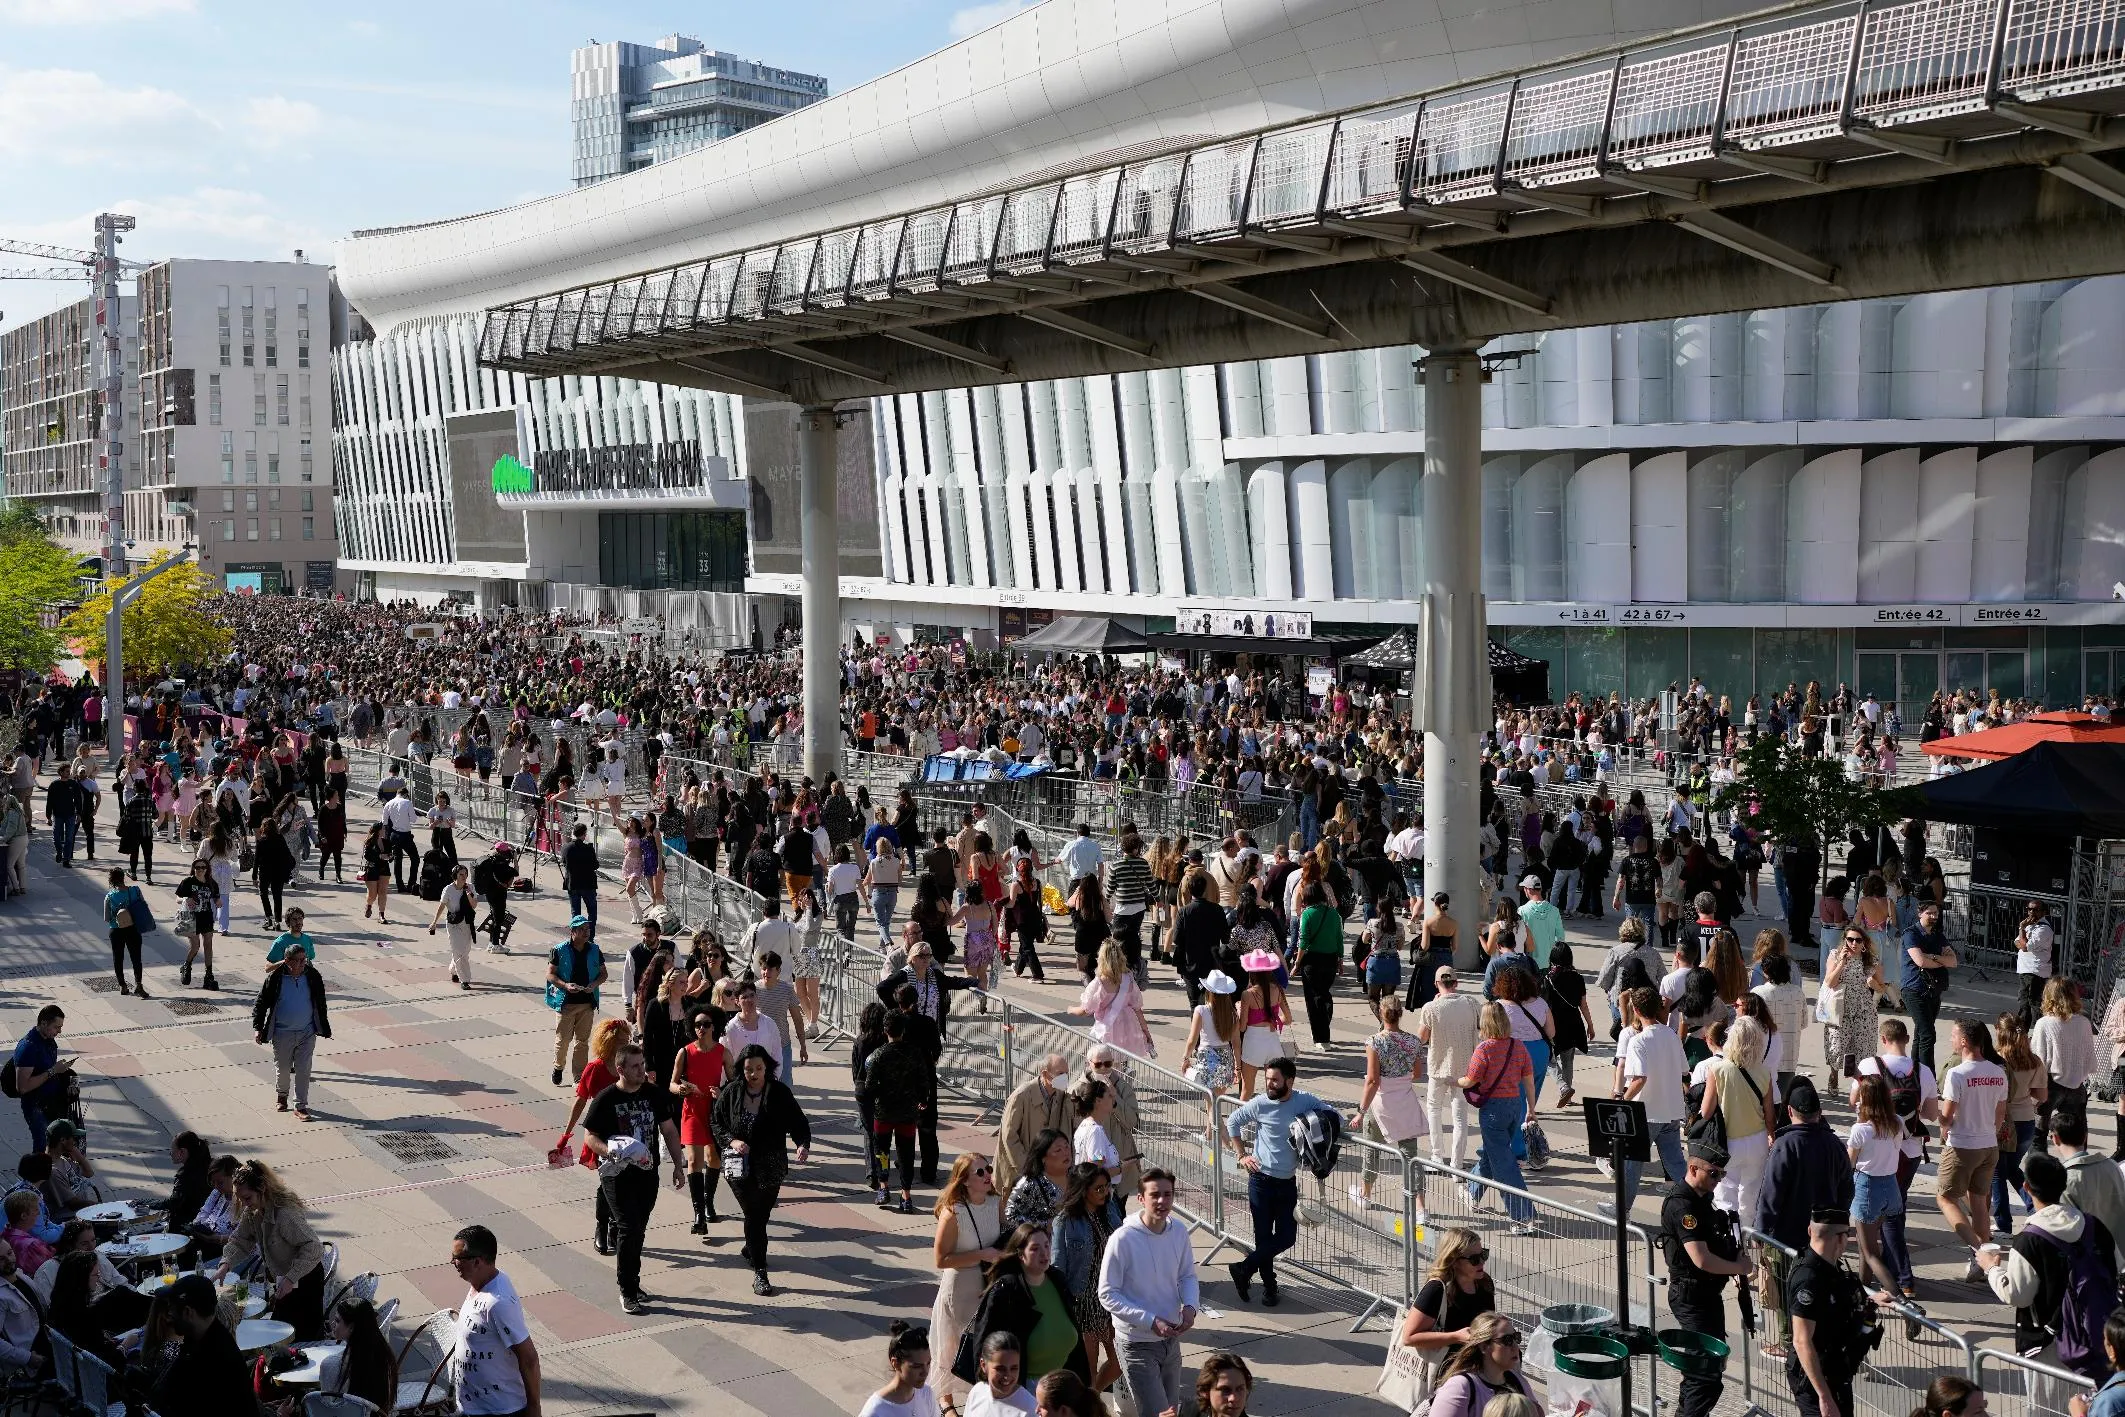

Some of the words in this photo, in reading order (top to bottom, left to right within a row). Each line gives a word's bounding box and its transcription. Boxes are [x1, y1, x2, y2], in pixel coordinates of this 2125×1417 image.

[534, 449, 571, 491] PARIS
[657, 440, 702, 488] ARENA
[699, 559, 709, 572] 33
[1573, 609, 1578, 619] 1
[1582, 608, 1589, 619] à
[1593, 609, 1606, 619] 41
[1623, 609, 1640, 619] 42
[1643, 609, 1651, 619] à
[1655, 609, 1671, 619] 67
[1878, 609, 1922, 620] Entrée
[1926, 609, 1943, 619] 42
[1978, 608, 2021, 619] Entrée
[2025, 608, 2041, 618] 42
[1967, 1077, 2004, 1087] LIFEGUARD
